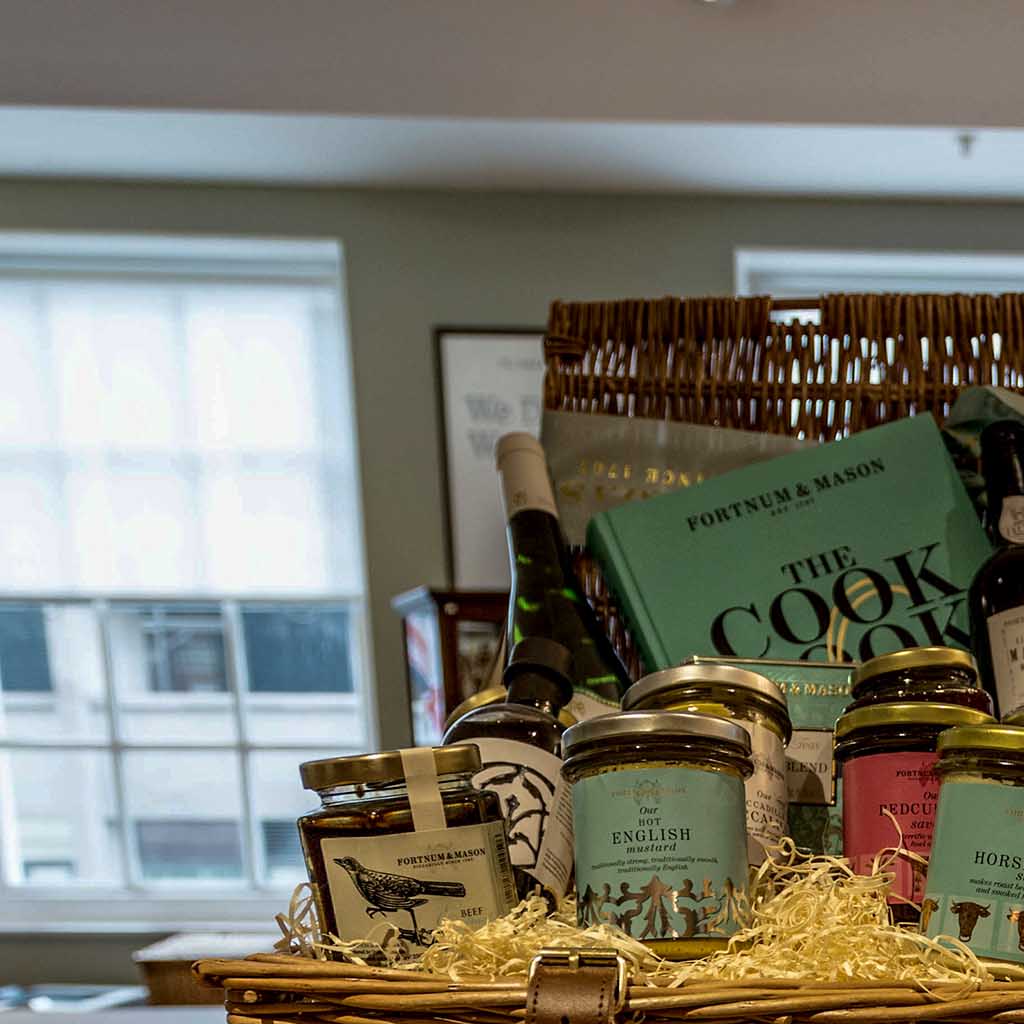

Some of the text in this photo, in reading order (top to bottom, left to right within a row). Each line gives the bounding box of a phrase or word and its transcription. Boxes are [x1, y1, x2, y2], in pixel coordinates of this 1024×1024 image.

[685, 488, 791, 531] FORTNUM
[797, 483, 810, 497] &
[813, 458, 886, 492] MASON
[781, 545, 857, 584] THE
[710, 542, 969, 658] COOK
[804, 683, 850, 697] MASO
[640, 806, 658, 814] Our
[638, 818, 662, 826] HOT
[612, 828, 691, 845] ENGLISH
[626, 842, 677, 854] mustard
[397, 853, 445, 867] FORTNUM
[454, 848, 486, 858] MASON
[461, 907, 483, 918] BEEF
